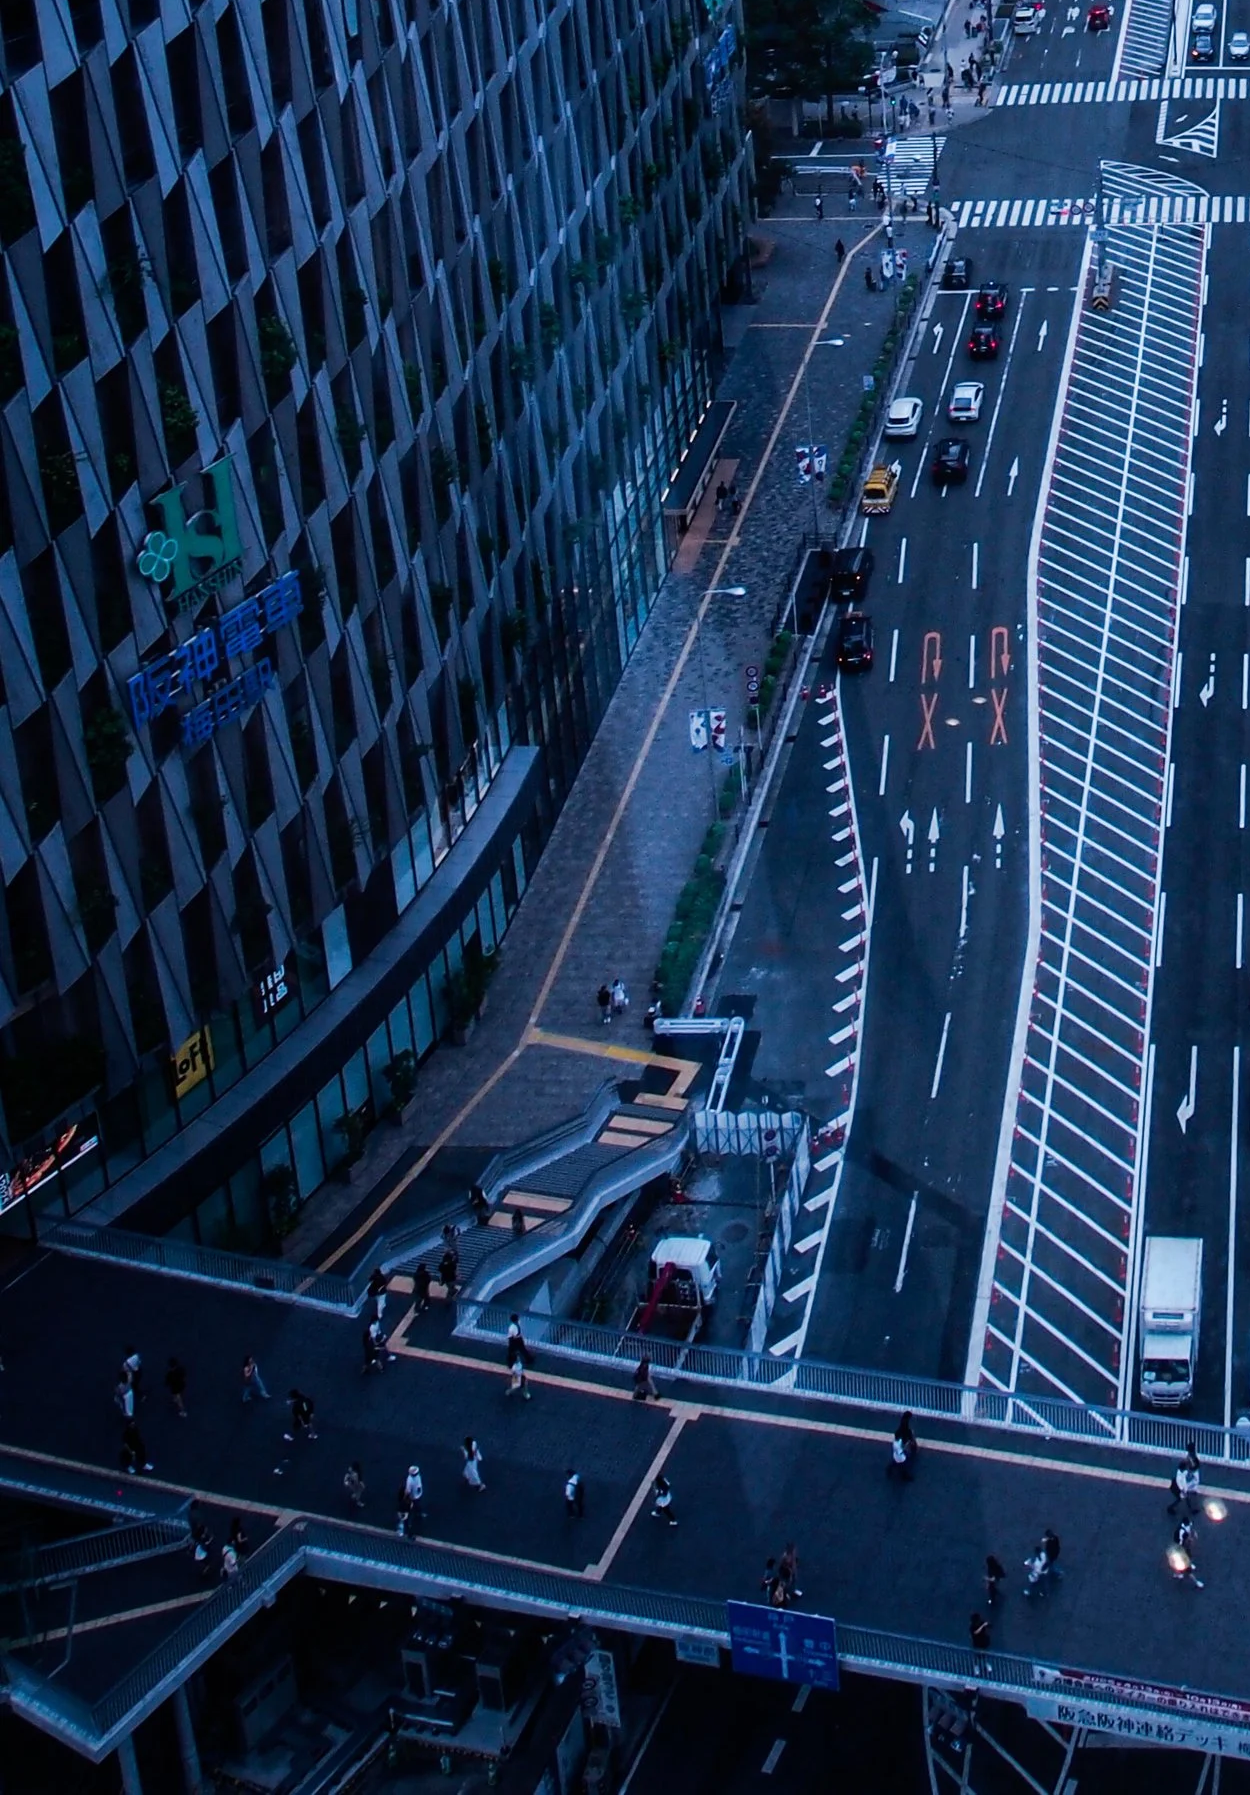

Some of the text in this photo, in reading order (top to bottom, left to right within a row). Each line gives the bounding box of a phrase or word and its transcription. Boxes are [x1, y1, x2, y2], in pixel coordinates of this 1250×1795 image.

[127, 568, 304, 730] 阪神電車
[1056, 1704, 1228, 1752] 阪急阪神連絡デッキ
